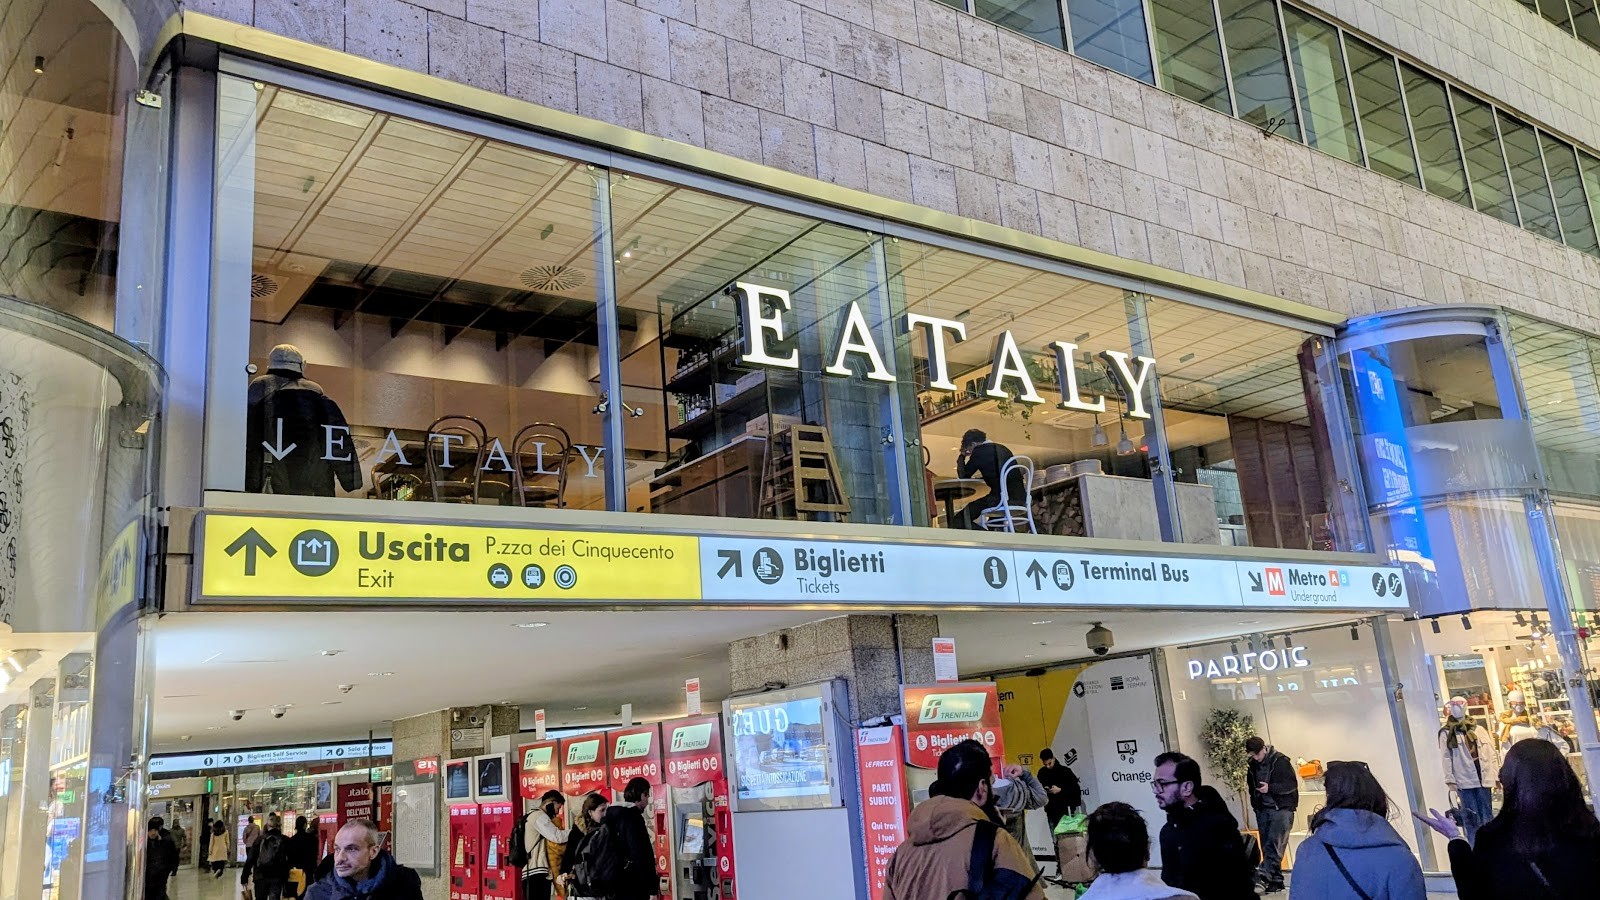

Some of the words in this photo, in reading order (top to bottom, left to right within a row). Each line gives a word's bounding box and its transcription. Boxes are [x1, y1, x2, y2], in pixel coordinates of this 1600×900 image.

[733, 281, 1156, 419] EATALY
[320, 424, 606, 478] EATALY
[359, 531, 470, 562] Uscita
[486, 536, 532, 556] P.zza
[539, 538, 566, 557] dei
[572, 539, 675, 562] Cinquecento
[794, 548, 886, 577] Biglietti
[358, 568, 394, 588] Exit
[1080, 560, 1157, 582] Terminal
[1163, 563, 1190, 583] Bus
[796, 577, 840, 594] Tickets
[1267, 571, 1284, 592] M
[1288, 569, 1327, 586] Metro
[1290, 590, 1337, 604] Underground
[1188, 646, 1309, 680] PARFOIS
[941, 711, 979, 719] TRENITALIA
[683, 739, 708, 748] TRENITALIA
[625, 747, 648, 755] TRENITALIA
[677, 759, 701, 772] Biglietti
[872, 759, 895, 768] FRECCE
[571, 771, 590, 783] Biglietti
[620, 766, 642, 778] Biglietti
[1111, 770, 1152, 783] Change
[872, 783, 892, 793] PARTI
[869, 796, 897, 806] SUBITO!
[346, 807, 371, 817] DELL'ALTA
[871, 821, 883, 831] Qui
[884, 821, 900, 831] trovi
[882, 834, 895, 842] tuoi
